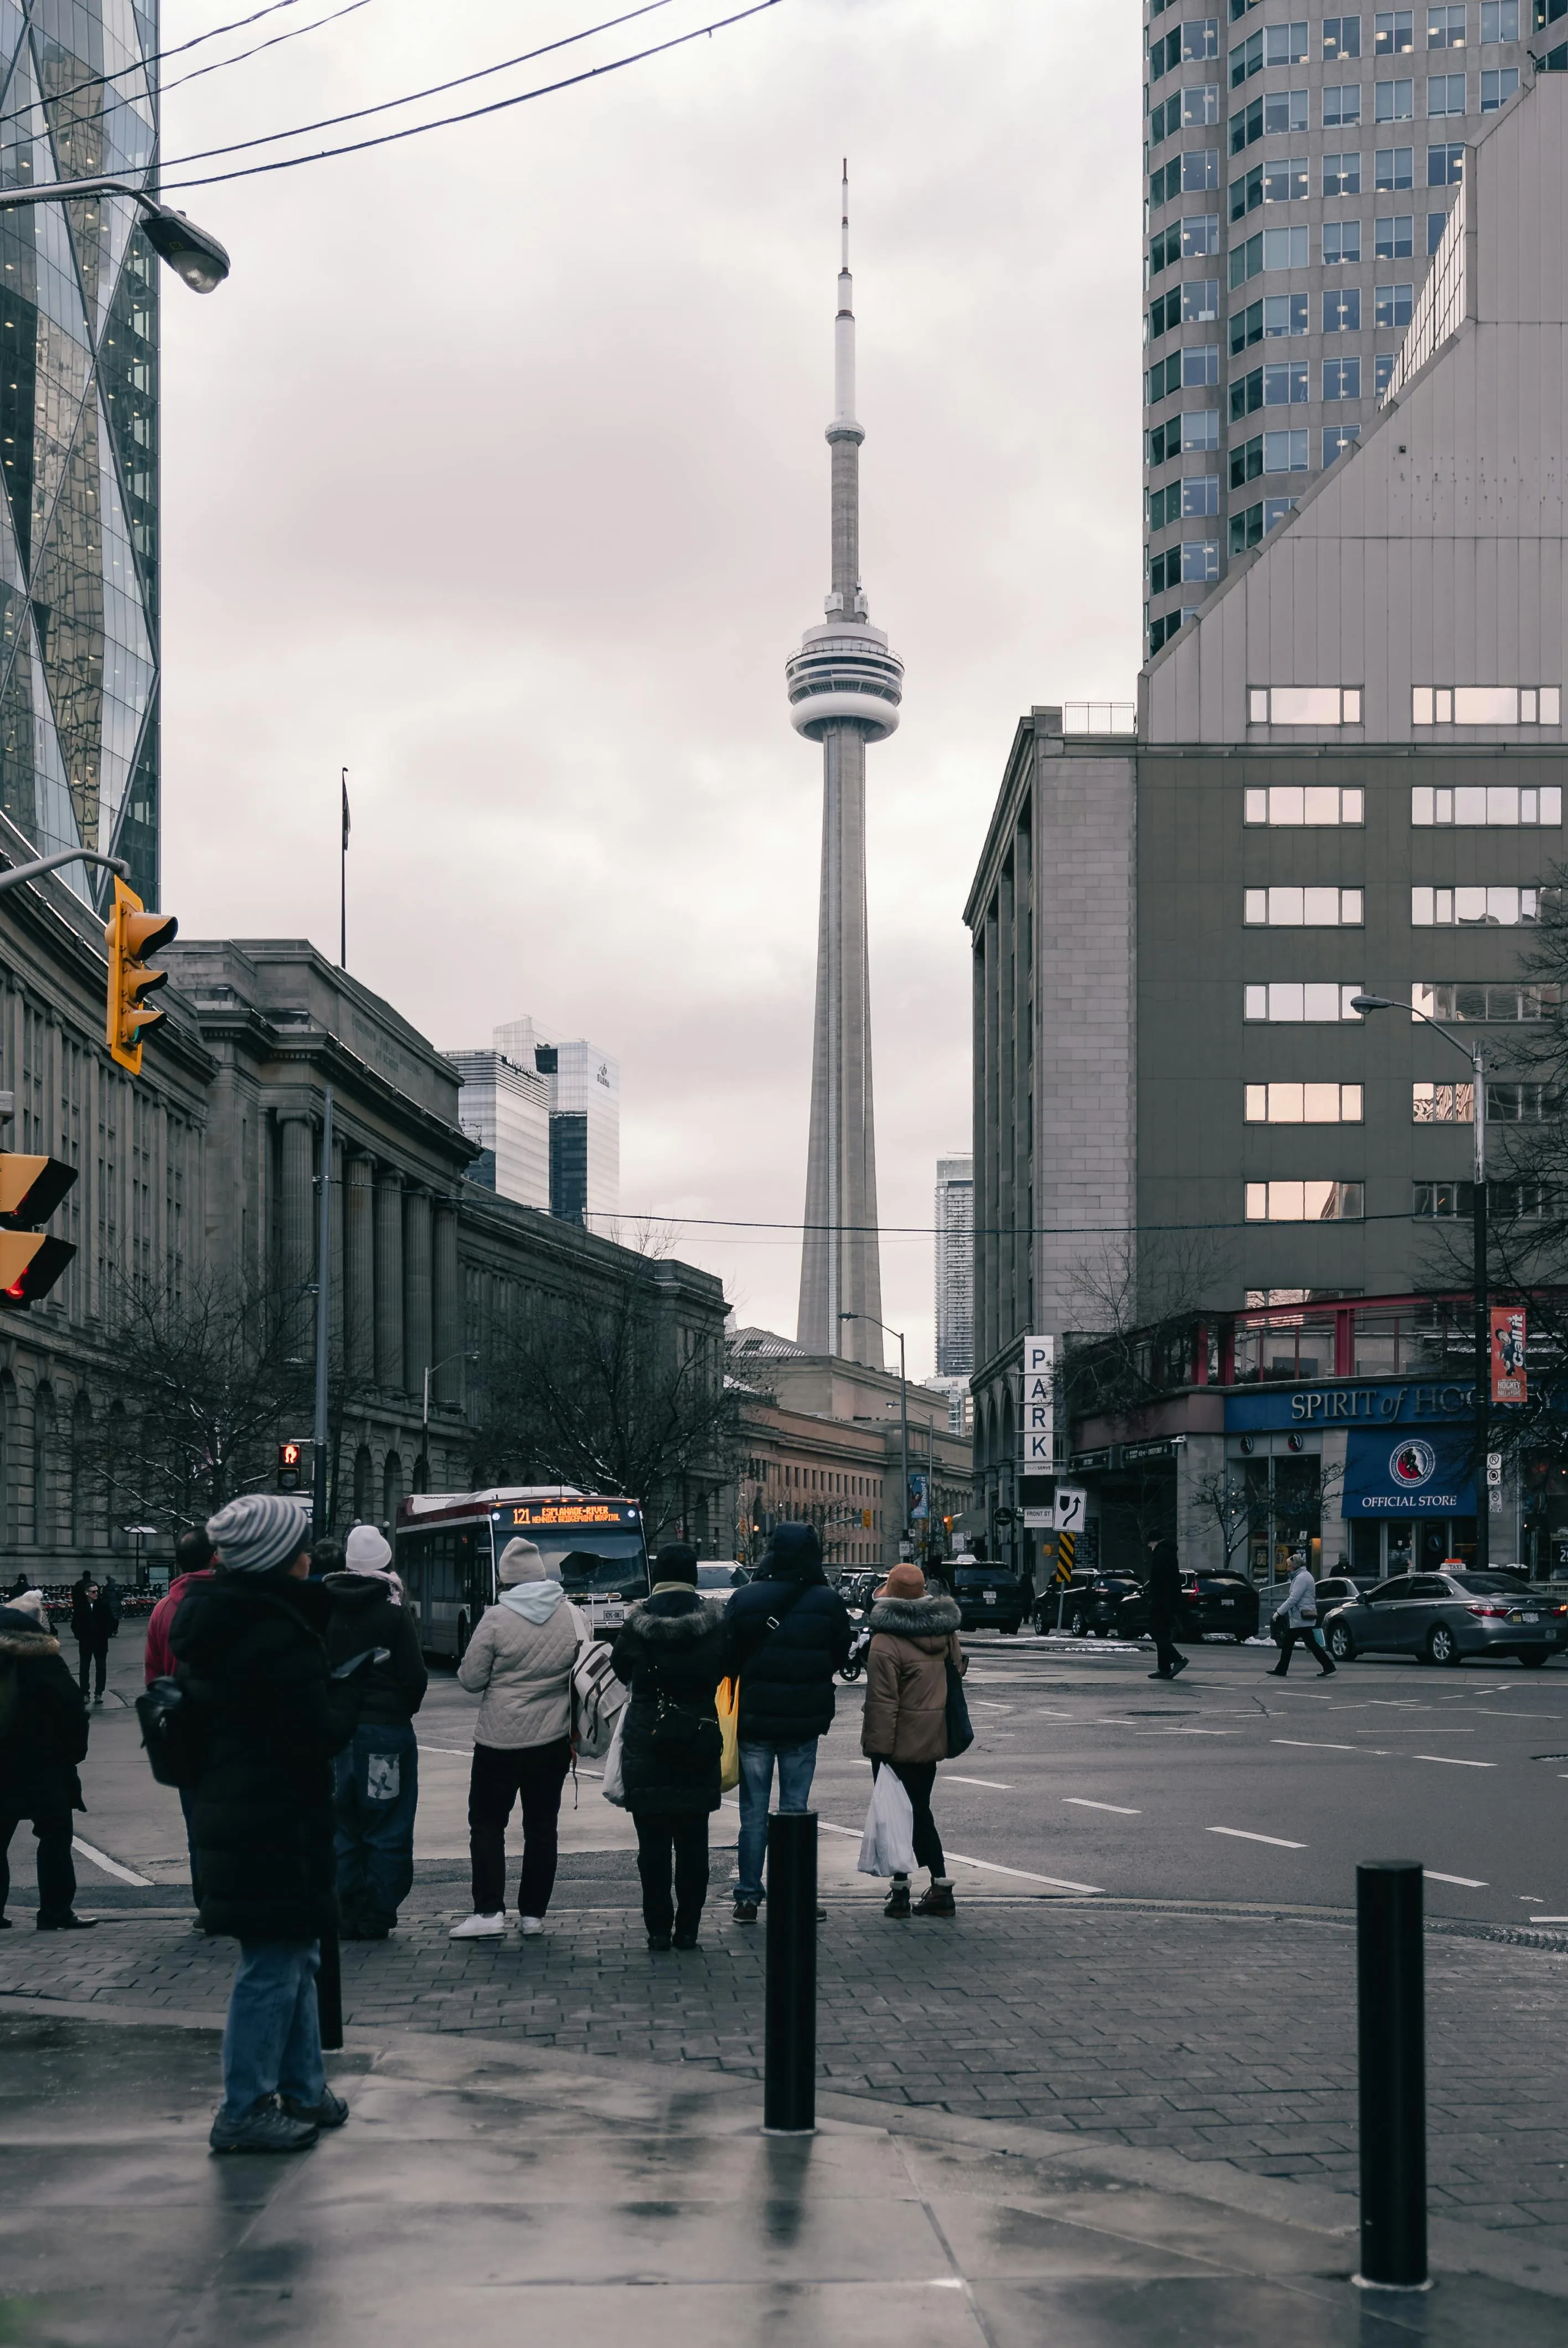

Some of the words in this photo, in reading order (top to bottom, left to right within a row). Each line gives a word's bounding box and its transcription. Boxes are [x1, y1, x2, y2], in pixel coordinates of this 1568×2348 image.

[1512, 1314, 1523, 1327] it
[1512, 1330, 1523, 1367] call
[1031, 1350, 1046, 1456] PARK
[1292, 1391, 1376, 1420] SPIRIT
[1381, 1388, 1407, 1422] of
[1362, 1496, 1416, 1507] OFFICIAL
[1419, 1495, 1457, 1506] STORE
[513, 1508, 530, 1524] 121
[541, 1506, 608, 1516] ESPLANADE-RIVER
[558, 1515, 594, 1523] BRIDGEPOINT
[595, 1513, 620, 1522] HOSPITAL
